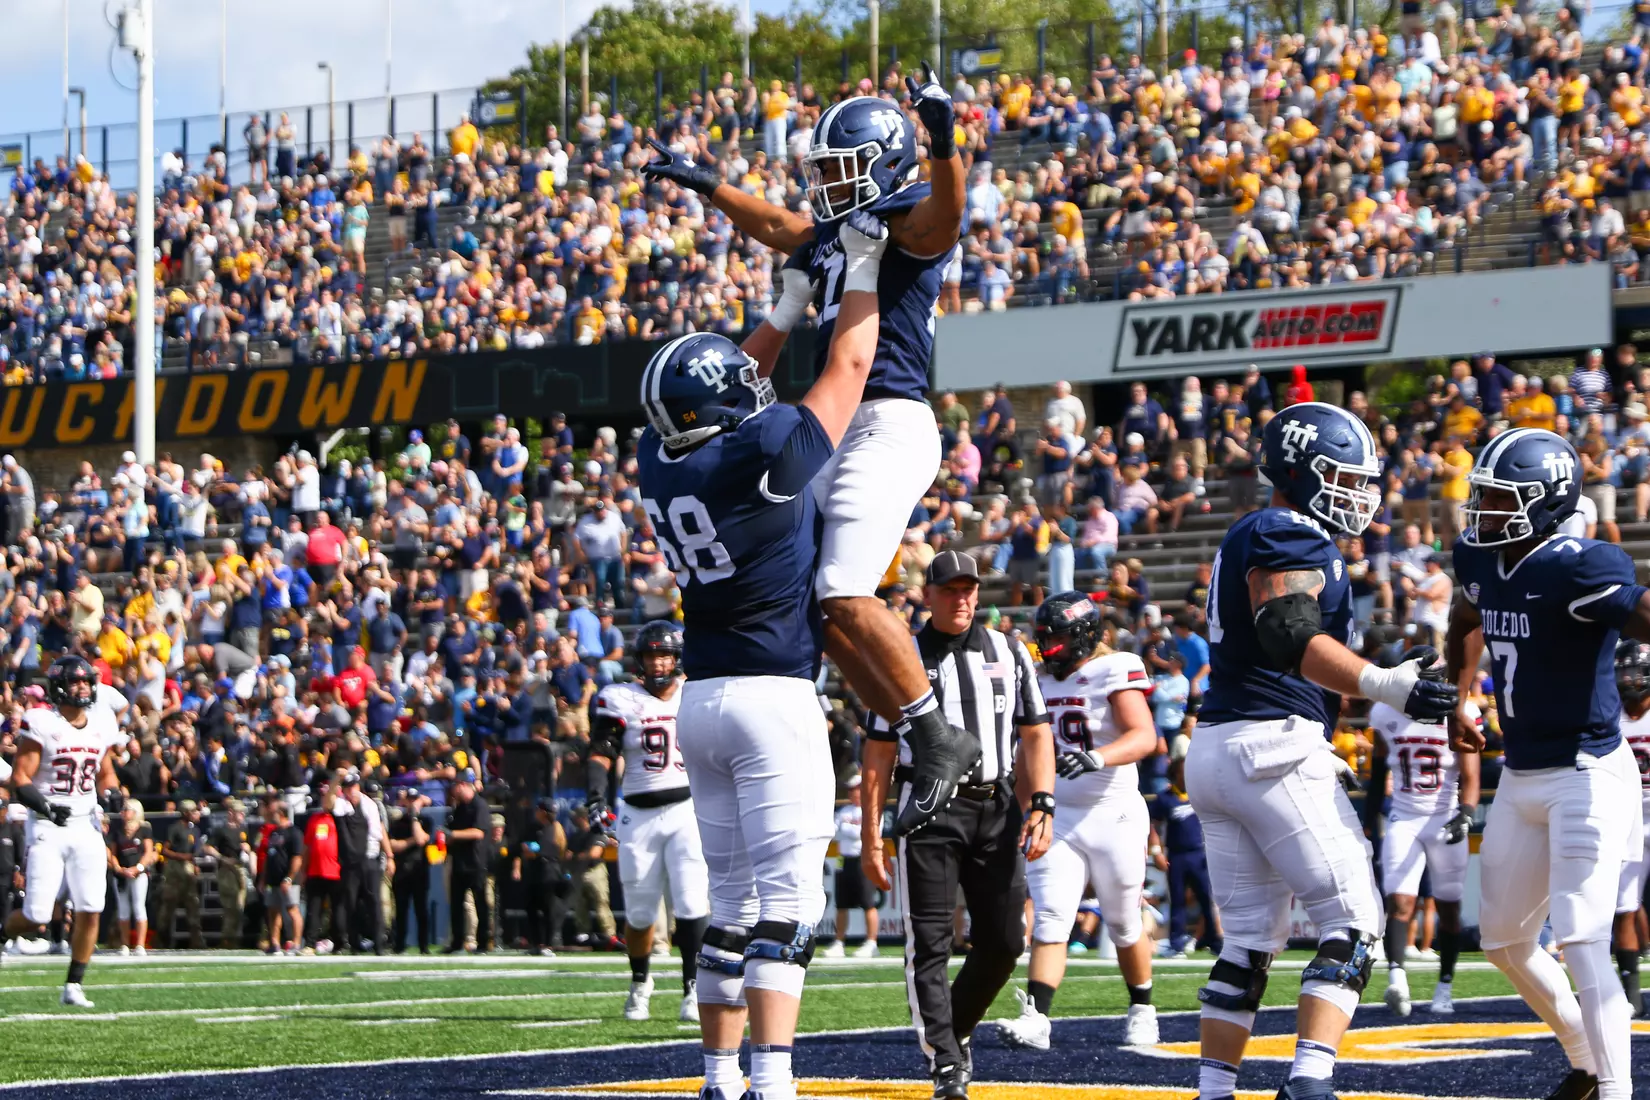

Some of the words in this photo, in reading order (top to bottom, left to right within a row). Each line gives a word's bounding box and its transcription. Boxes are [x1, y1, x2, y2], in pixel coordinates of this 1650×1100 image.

[1129, 308, 1256, 357] YARK
[1253, 310, 1378, 340] AUTO.COM
[682, 410, 697, 423] 54
[642, 494, 738, 588] 68
[1481, 608, 1531, 638] TOLEDO
[1490, 640, 1519, 718] 7
[995, 694, 1007, 713] B
[1047, 709, 1094, 757] 9
[51, 757, 99, 796] 38
[1397, 747, 1443, 795] 13
